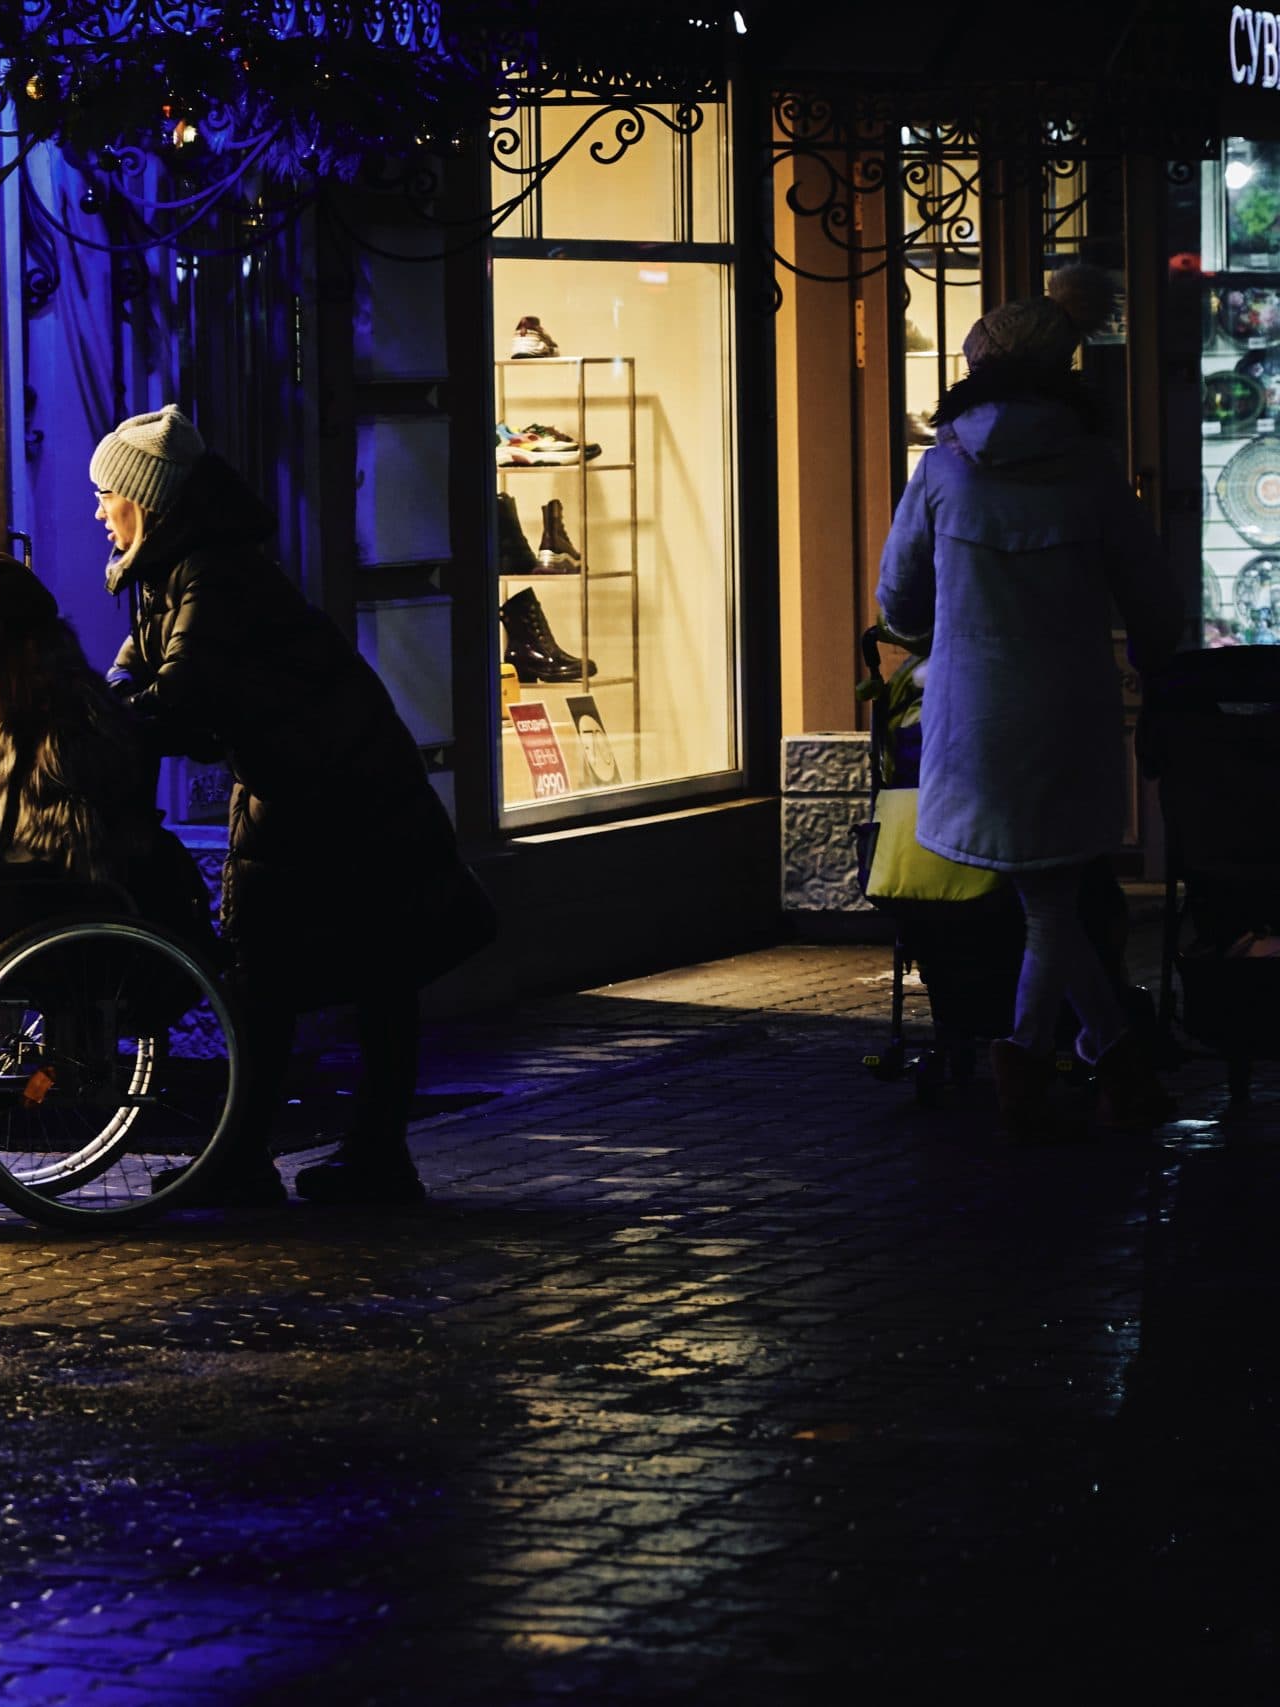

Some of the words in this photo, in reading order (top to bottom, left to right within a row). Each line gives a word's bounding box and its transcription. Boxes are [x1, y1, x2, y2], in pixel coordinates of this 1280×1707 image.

[1229, 4, 1280, 90] СУВ
[528, 748, 558, 768] ЦЕНЫ
[536, 772, 566, 797] 4990
